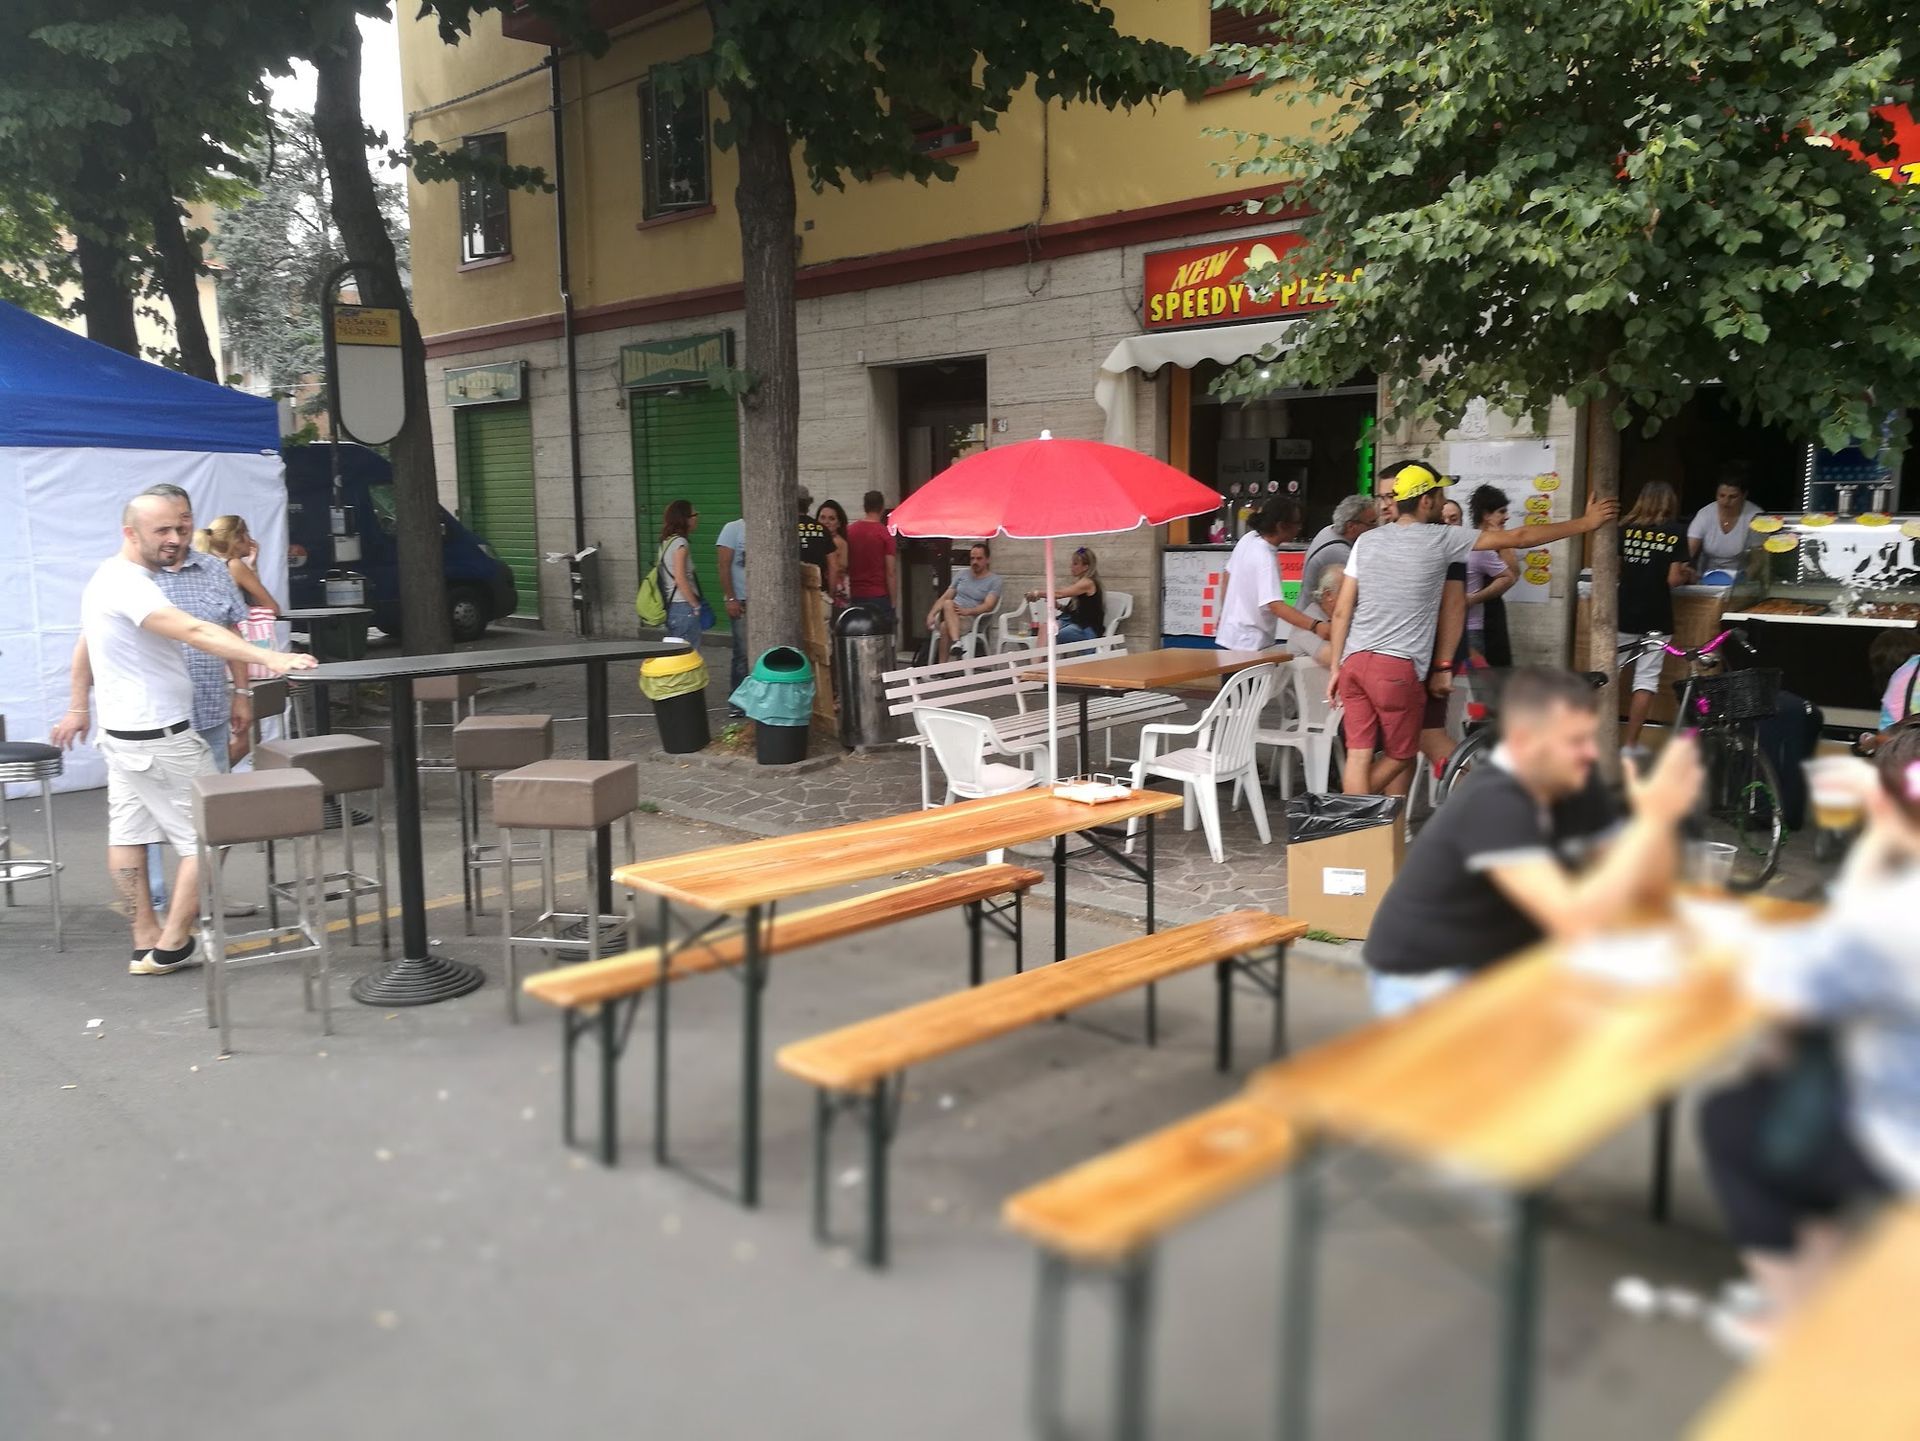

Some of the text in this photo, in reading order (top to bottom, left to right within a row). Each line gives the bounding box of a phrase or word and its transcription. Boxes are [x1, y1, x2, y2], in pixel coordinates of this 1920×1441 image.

[1171, 246, 1239, 291] NEW
[1149, 283, 1245, 322] SPEEDY
[1625, 529, 1679, 544] VASCO
